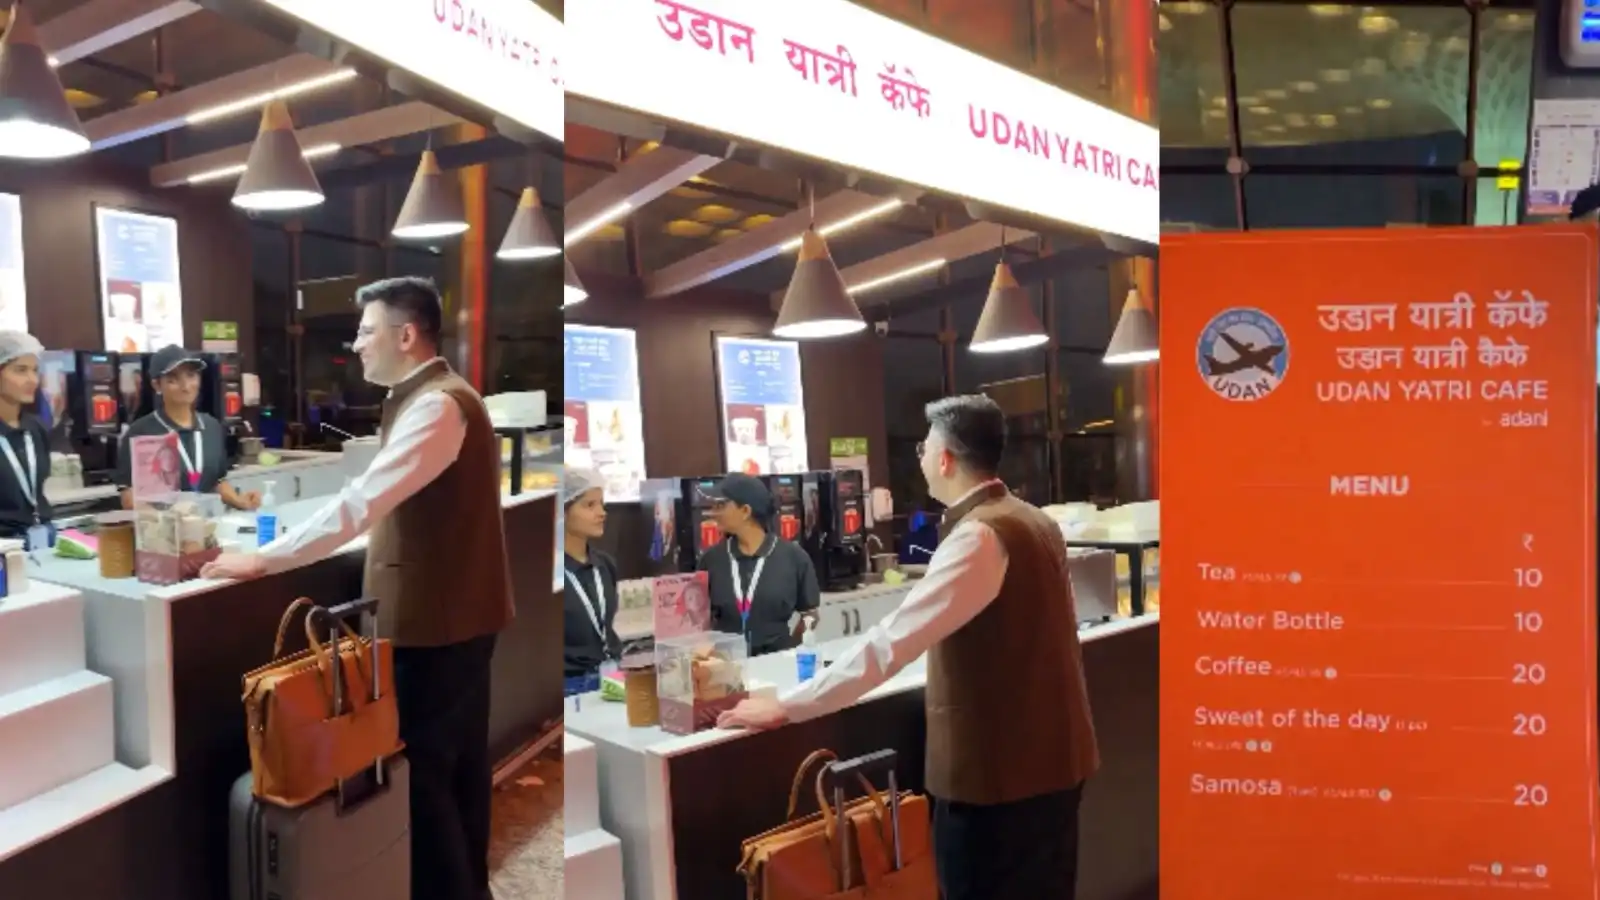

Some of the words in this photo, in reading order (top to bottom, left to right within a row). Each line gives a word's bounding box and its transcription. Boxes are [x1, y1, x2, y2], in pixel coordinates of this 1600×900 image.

[654, 0, 757, 64] उडान
[782, 38, 859, 98] यात्री
[968, 103, 1050, 160] UDAN
[1055, 132, 1121, 181] YATRI
[1126, 157, 1158, 190] CA
[1316, 302, 1398, 332] उडान
[1407, 291, 1476, 332] यात्री
[1411, 336, 1470, 370] यात्री
[1213, 377, 1272, 400] UDAN
[1316, 380, 1391, 402] UDAN
[1398, 379, 1473, 402] YATRI
[1480, 379, 1549, 401] CAFE
[1499, 408, 1549, 428] adani
[1329, 475, 1410, 497] MENU
[1196, 562, 1236, 582] Tea
[1512, 567, 1544, 589] 10
[1197, 610, 1266, 630] Water
[1272, 610, 1345, 631] Bottle
[1513, 611, 1544, 633] 10
[1194, 655, 1273, 676] Coffee
[1511, 662, 1547, 685] 20
[1194, 705, 1264, 728] Sweet
[1271, 708, 1297, 728] of
[1303, 708, 1341, 729] the
[1347, 709, 1391, 734] day
[1512, 712, 1548, 737] 20
[1190, 773, 1283, 797] Samosa
[1513, 783, 1549, 807] 20
